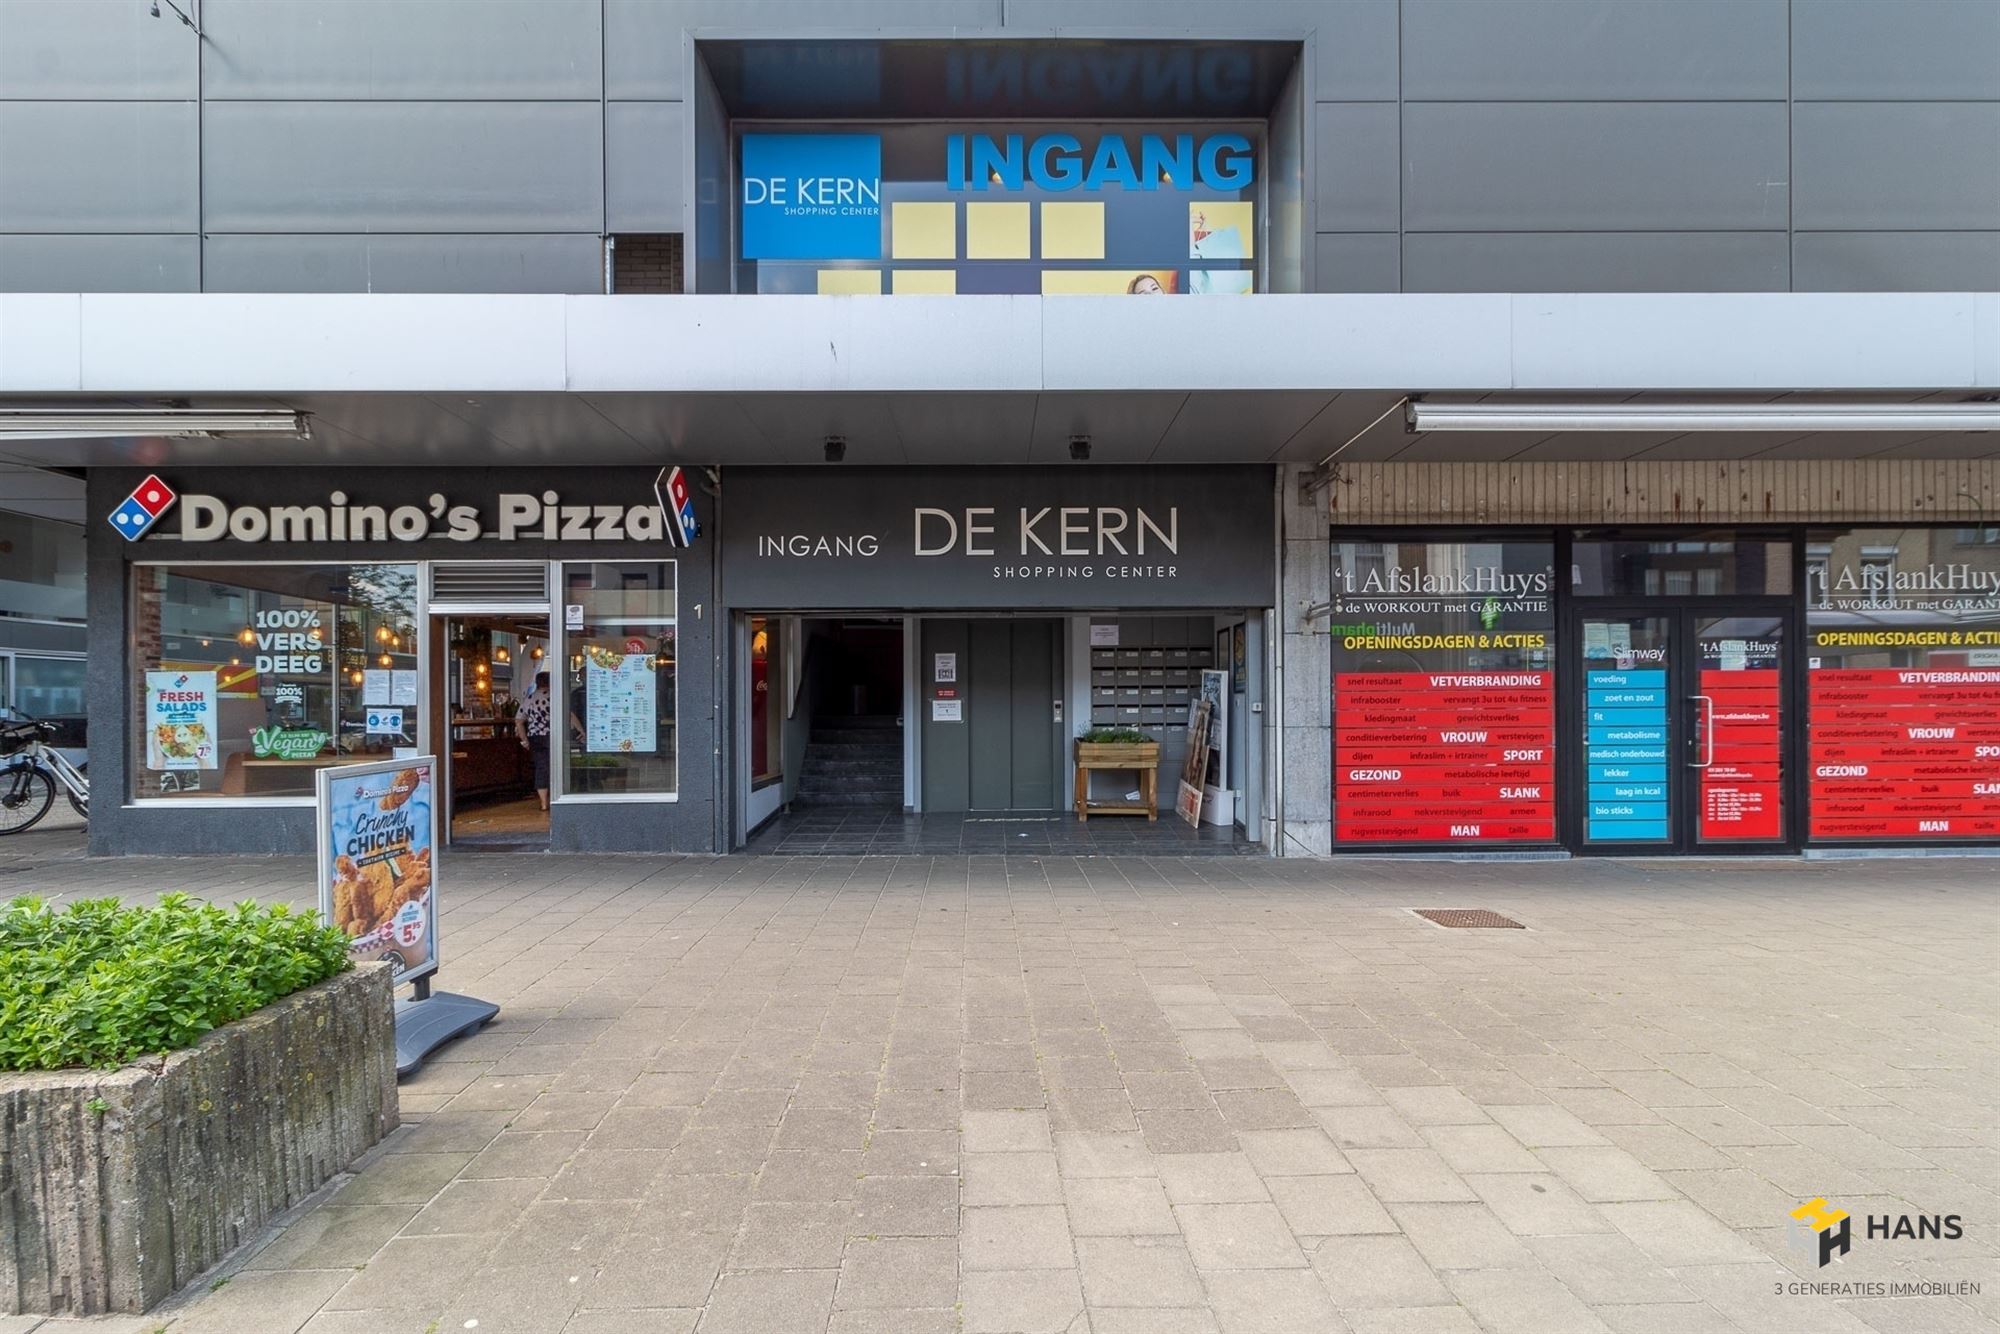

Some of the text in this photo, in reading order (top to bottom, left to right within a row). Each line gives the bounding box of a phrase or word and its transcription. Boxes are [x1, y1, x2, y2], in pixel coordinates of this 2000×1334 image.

[946, 132, 1254, 192] INGANG
[744, 177, 880, 205] DE KERN
[784, 207, 880, 216] SHOPPING CENTER
[180, 489, 663, 543] Domino's Pizza
[914, 506, 1178, 556] DE KERN
[758, 534, 880, 557] INGANG
[993, 565, 1178, 578] SHOPPING CENTER
[1361, 566, 1548, 600] AfslankHuys
[1345, 601, 1548, 613] de WORKOUT met GARANTIE
[1819, 600, 1834, 610] de
[1838, 600, 1914, 610] WORKOUT
[1917, 600, 1939, 610] met
[693, 604, 702, 620] 1
[256, 609, 321, 629] 100%
[255, 632, 322, 651] VERS
[1344, 634, 1545, 650] OPENINGSDAGEN & ACTIES
[1817, 631, 2000, 646] OPENINGSDAGEN & ACTI
[1613, 645, 1665, 662] Slimway
[255, 654, 322, 674] DEEG
[1347, 677, 1402, 686] snel resultaat
[1430, 675, 1541, 687] VETVERBRANDING
[1593, 675, 1627, 685] voeding
[160, 692, 204, 702] FRESH
[276, 688, 302, 696] 100%
[1350, 696, 1401, 704] infrabooster
[1443, 696, 1479, 705] vervangt
[1494, 695, 1506, 704] tot
[1507, 695, 1518, 703] 4u
[1520, 694, 1547, 703] fitness
[1604, 694, 1622, 702] zoet
[1636, 694, 1654, 702] zout
[156, 702, 207, 712] SALADS
[1364, 714, 1417, 724] kledingmaat
[1457, 713, 1520, 723] gewichtsverlies
[1594, 712, 1604, 721] fit
[1346, 733, 1427, 743] conditieverbetering
[1440, 732, 1488, 743] VROUW
[1497, 732, 1545, 742] verstevigen
[1607, 731, 1661, 740] metabolisme
[1908, 728, 1956, 739] VROUW
[252, 726, 320, 757] Vegan
[1352, 752, 1373, 761] dijen
[1410, 752, 1446, 760] infraslim
[1455, 751, 1489, 760] irtrainer
[1503, 750, 1544, 761] SPORT
[1590, 749, 1666, 759] medisch onderbouwd
[1350, 769, 1402, 781] GEZOND
[1444, 769, 1530, 780] metabolische leeftijd
[1604, 769, 1629, 777] lekker
[1816, 766, 1868, 777] GEZOND
[1348, 788, 1419, 798] centimeterverlies
[1442, 789, 1461, 798] buik
[1499, 787, 1540, 798] SLANK
[1615, 787, 1661, 797] laag in kcal
[1353, 807, 1392, 817] infrarood
[1414, 807, 1483, 817] nekverstevigend
[1510, 808, 1536, 816] armen
[1596, 806, 1634, 816] bio sticks
[355, 809, 409, 835] Crunchy
[1919, 820, 1949, 832] MAN
[1351, 827, 1419, 837] rugverstevigend
[1450, 825, 1480, 837] MAN
[1508, 826, 1529, 834] taille
[346, 825, 415, 857] CHICKEN
